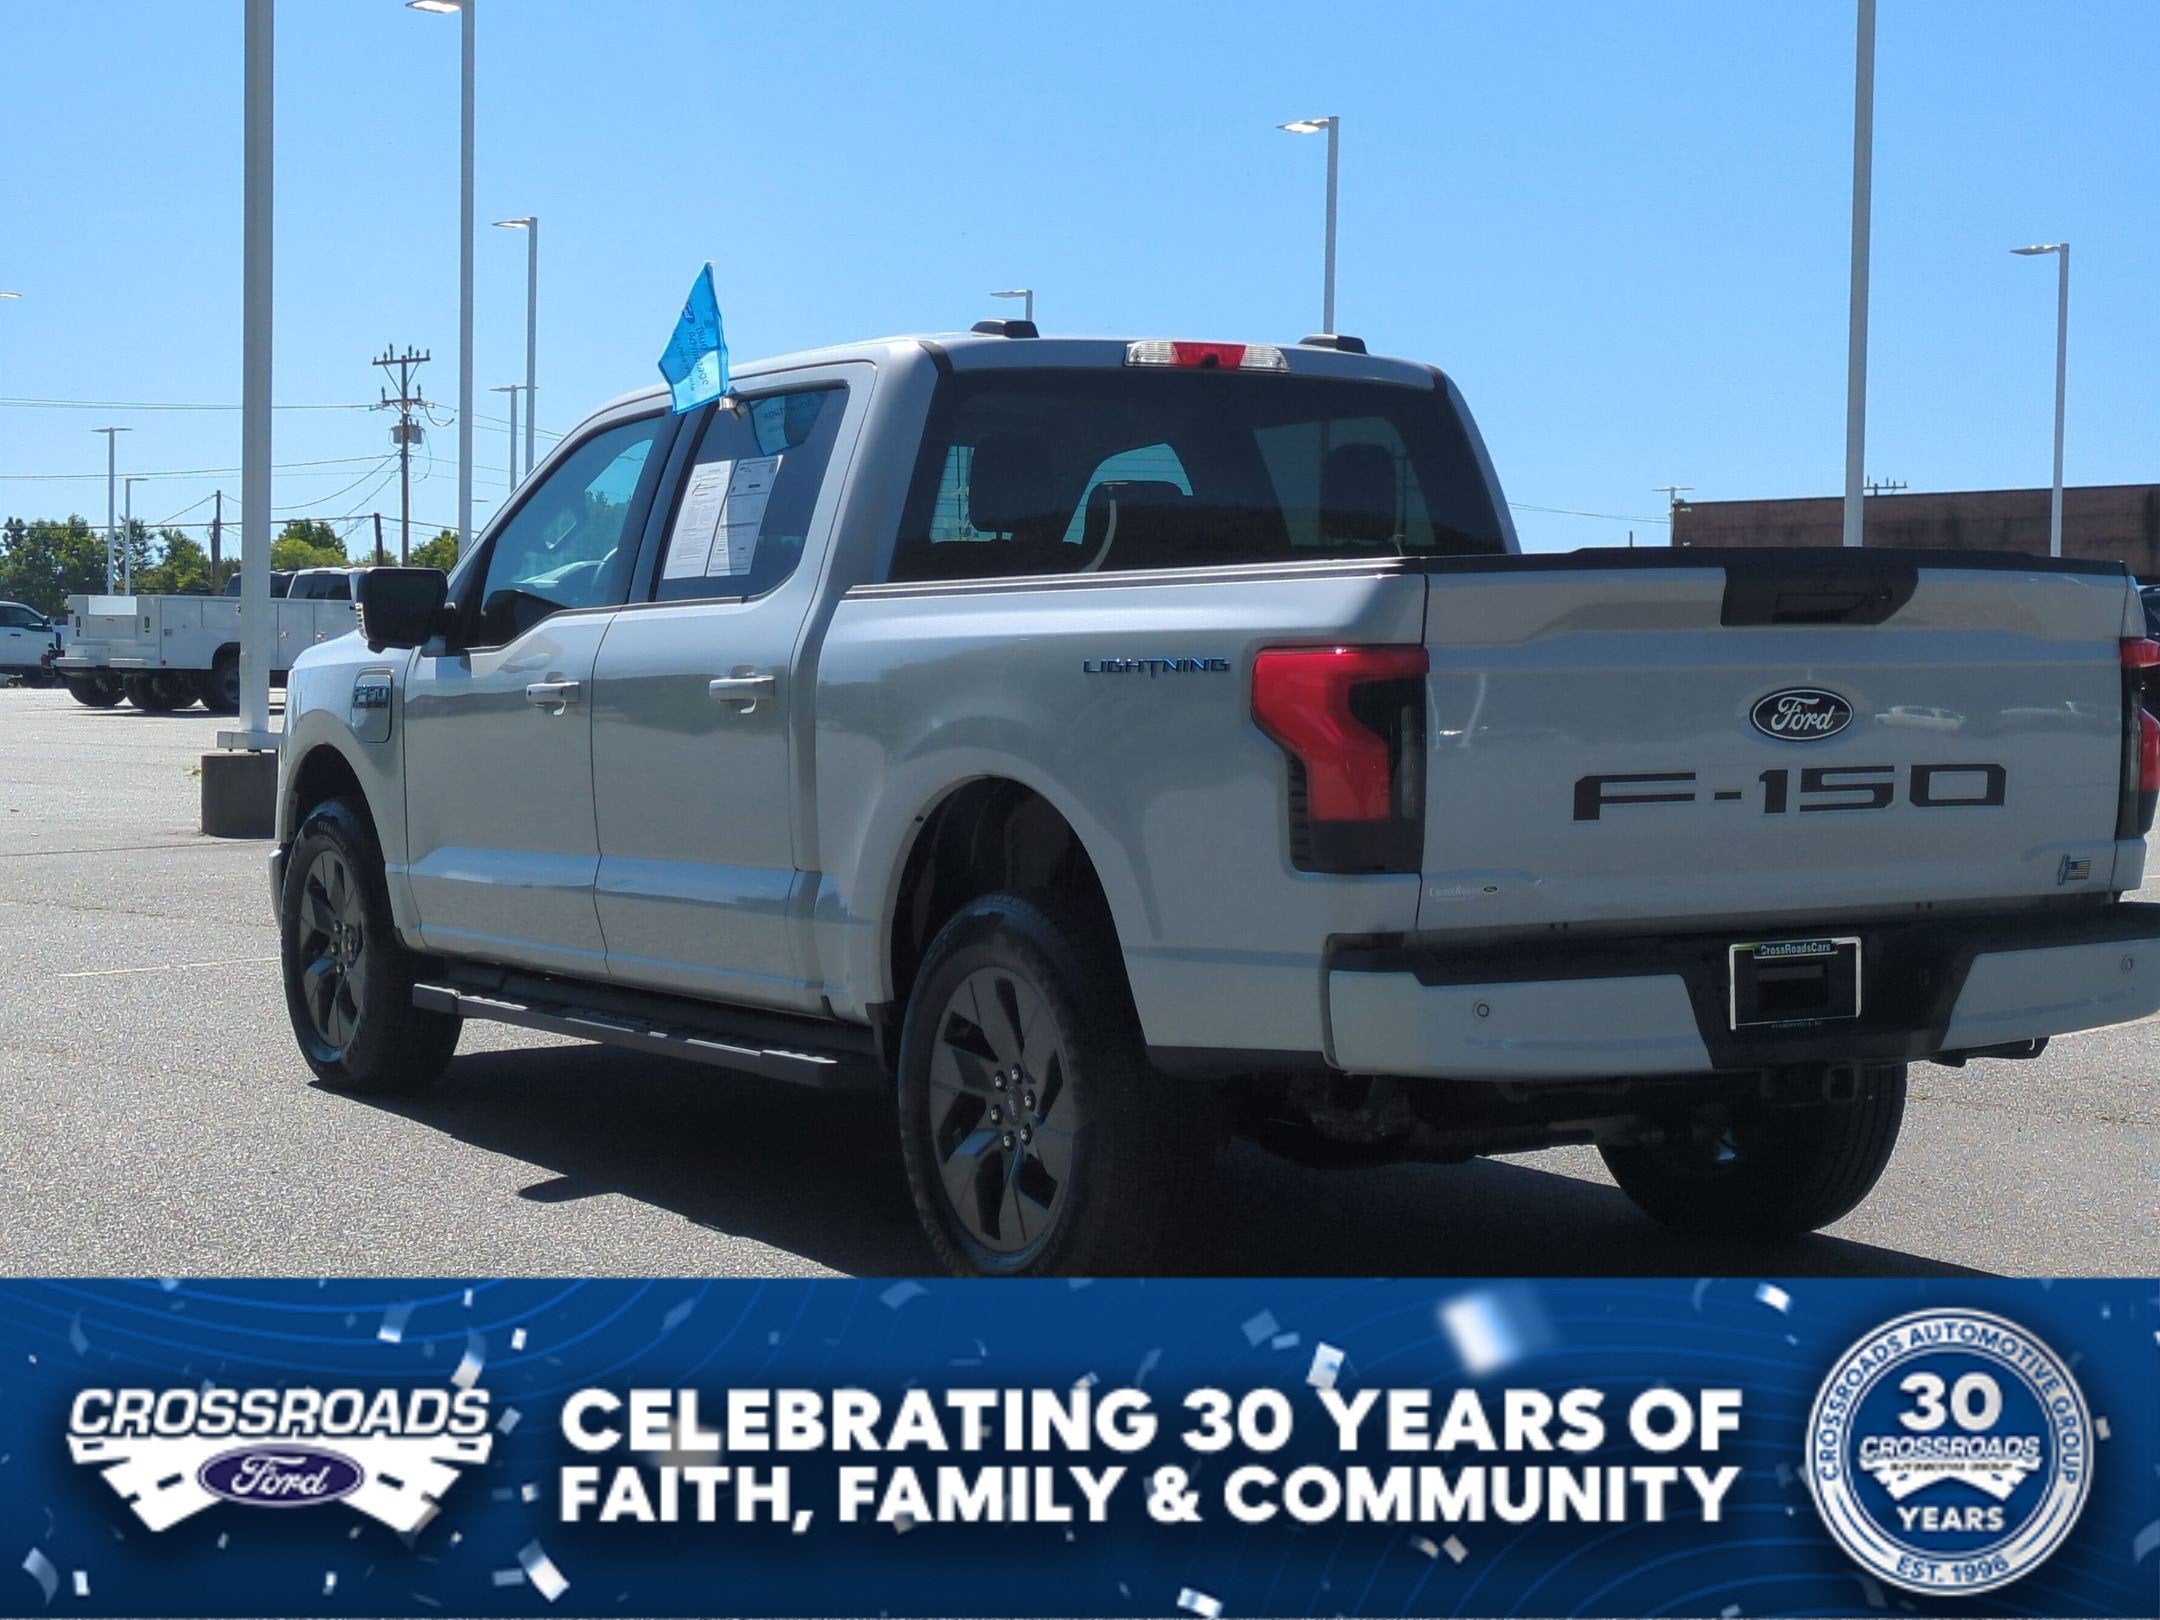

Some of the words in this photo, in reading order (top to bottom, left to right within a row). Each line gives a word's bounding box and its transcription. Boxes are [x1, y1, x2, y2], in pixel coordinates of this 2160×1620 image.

[1083, 657, 1231, 679] LIGHTNING
[1771, 696, 1836, 731] Ford
[1573, 763, 2007, 821] F-150
[1760, 943, 1832, 956] CrossRoadsCars
